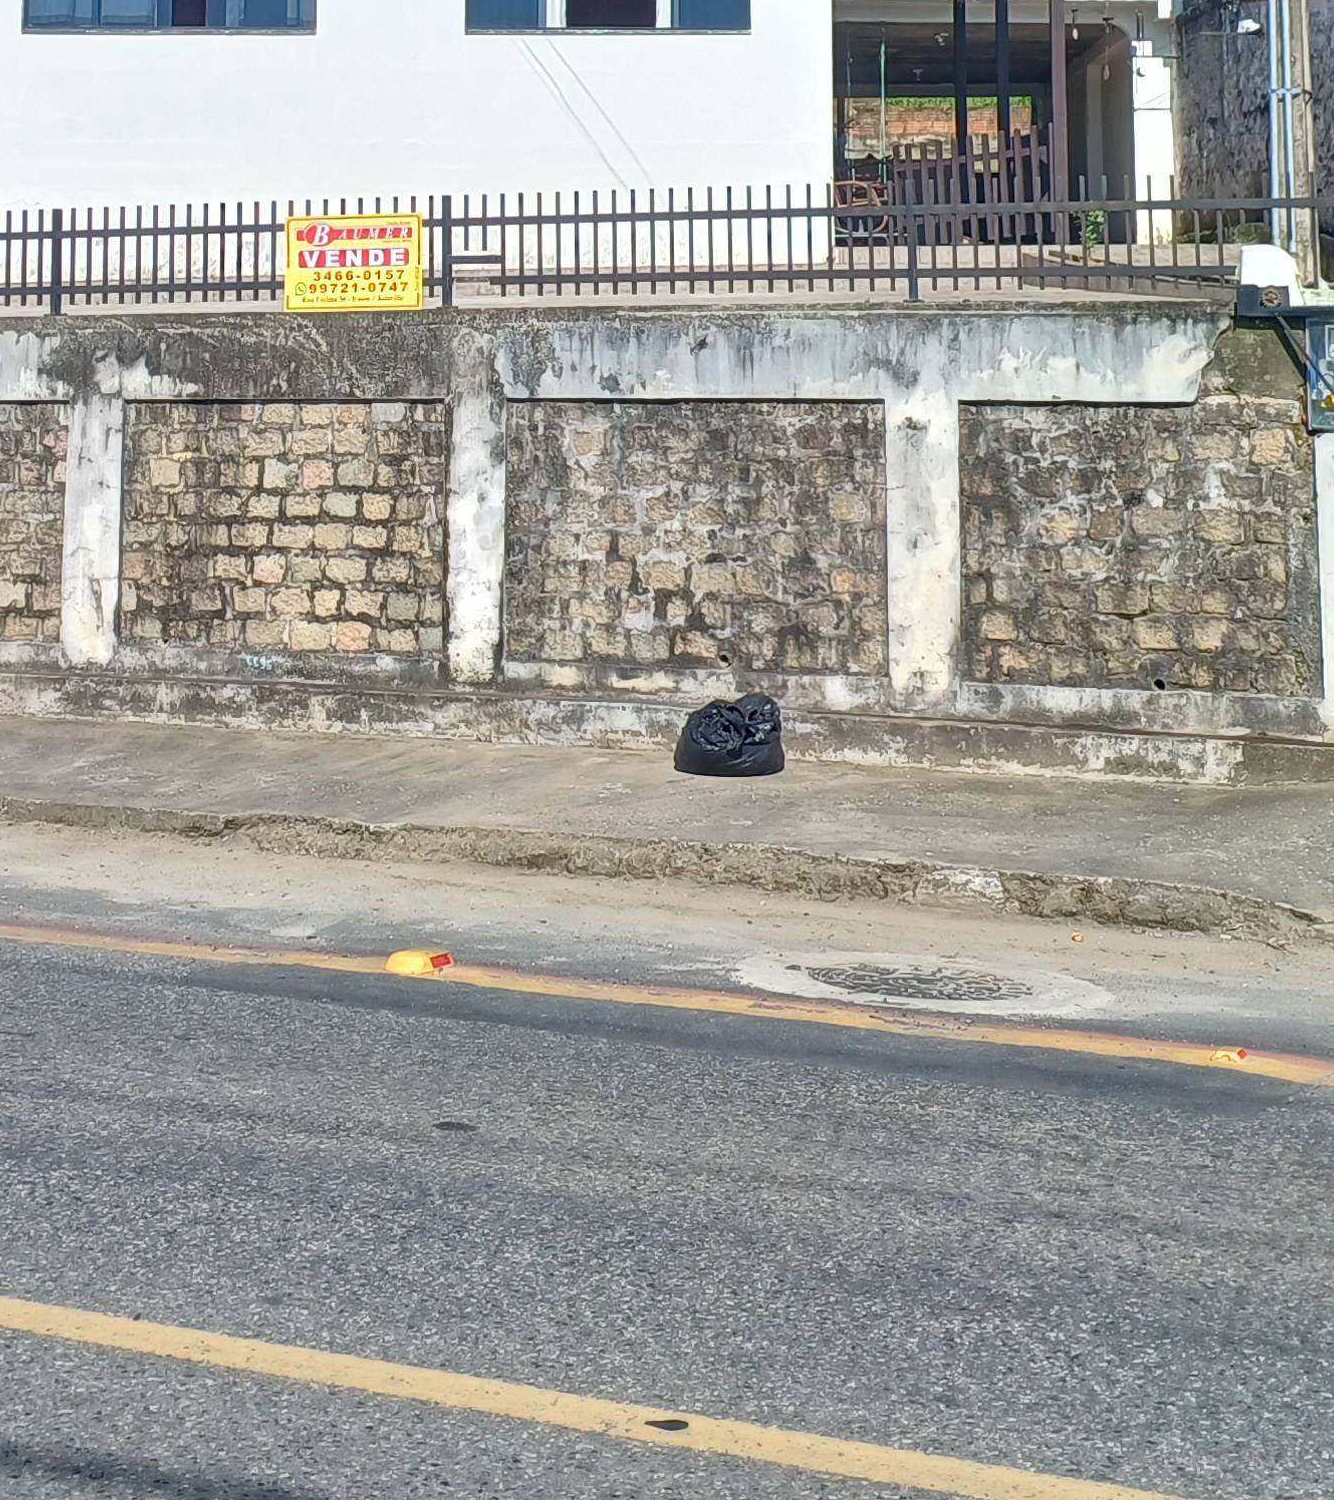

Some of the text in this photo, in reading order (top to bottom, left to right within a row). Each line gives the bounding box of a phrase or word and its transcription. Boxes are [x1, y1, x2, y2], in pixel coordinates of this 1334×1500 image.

[312, 224, 410, 245] BAUMER
[302, 249, 405, 268] VENDE
[313, 270, 405, 281] 3466-0157
[309, 282, 408, 294] 99721-0747
